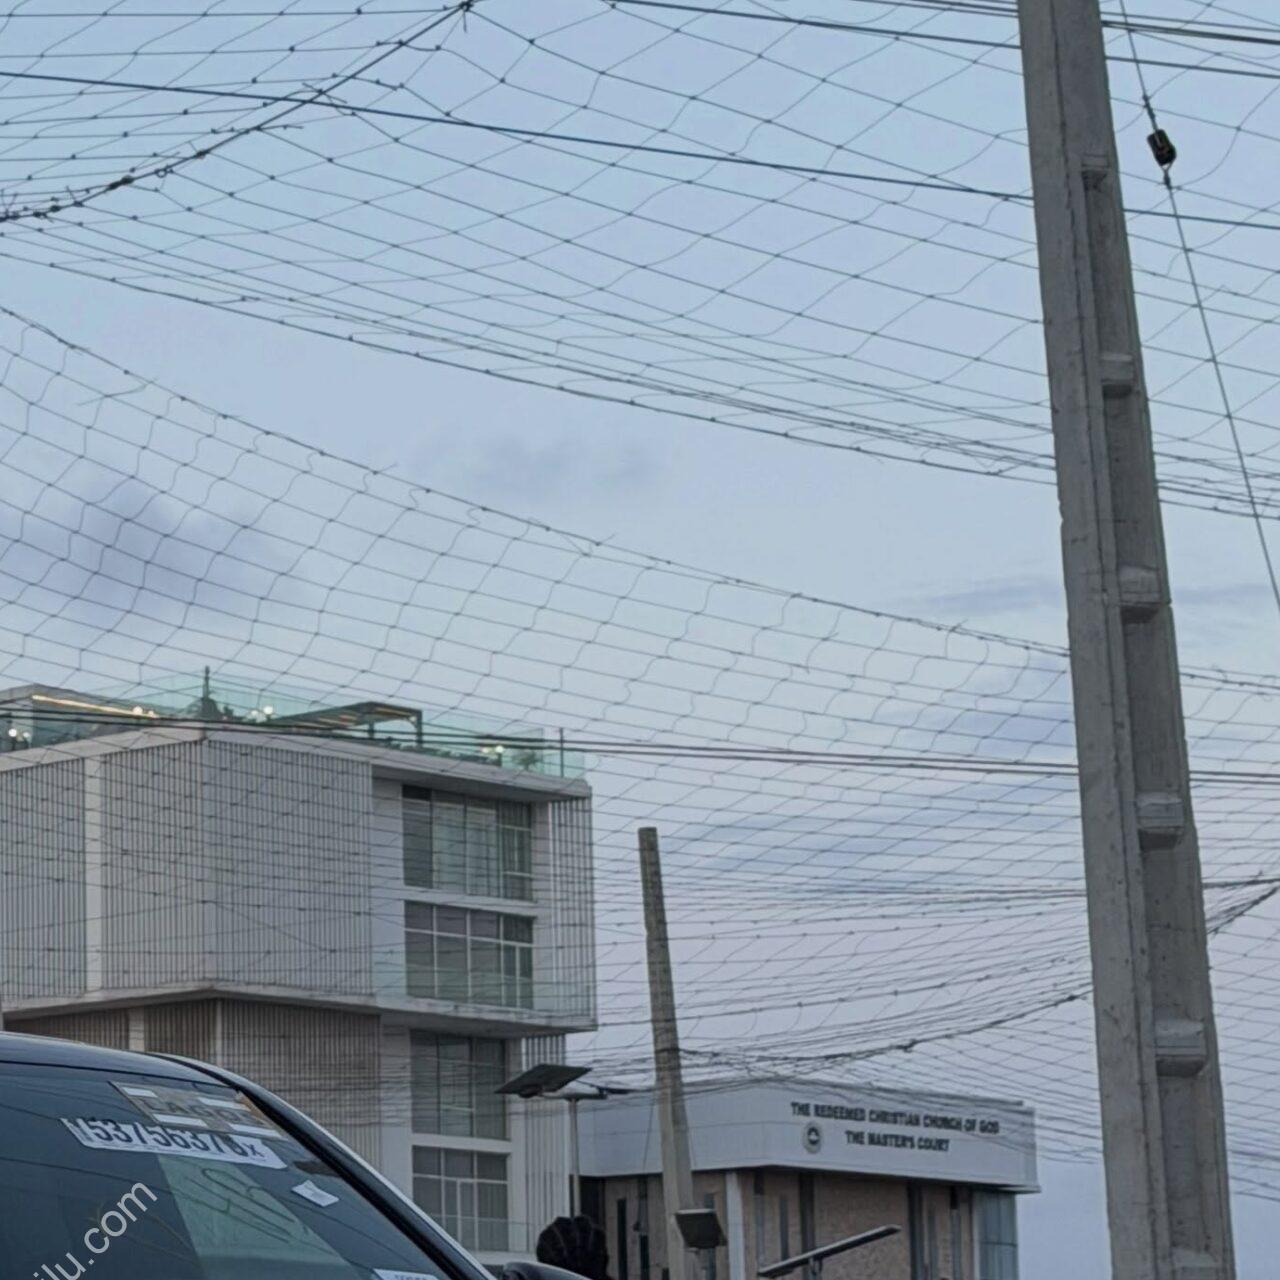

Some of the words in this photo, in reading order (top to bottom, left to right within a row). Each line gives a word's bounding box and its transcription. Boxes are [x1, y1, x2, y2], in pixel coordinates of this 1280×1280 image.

[791, 1102, 810, 1117] THE
[814, 1104, 866, 1121] REDEEMED
[869, 1109, 920, 1126] CHRISTIAN
[923, 1114, 962, 1131] CHURCH
[964, 1118, 977, 1132] OF
[979, 1120, 1000, 1134] GOD
[845, 1130, 865, 1145] THE
[868, 1132, 915, 1149] MASTER'S
[918, 1137, 950, 1152] COURT
